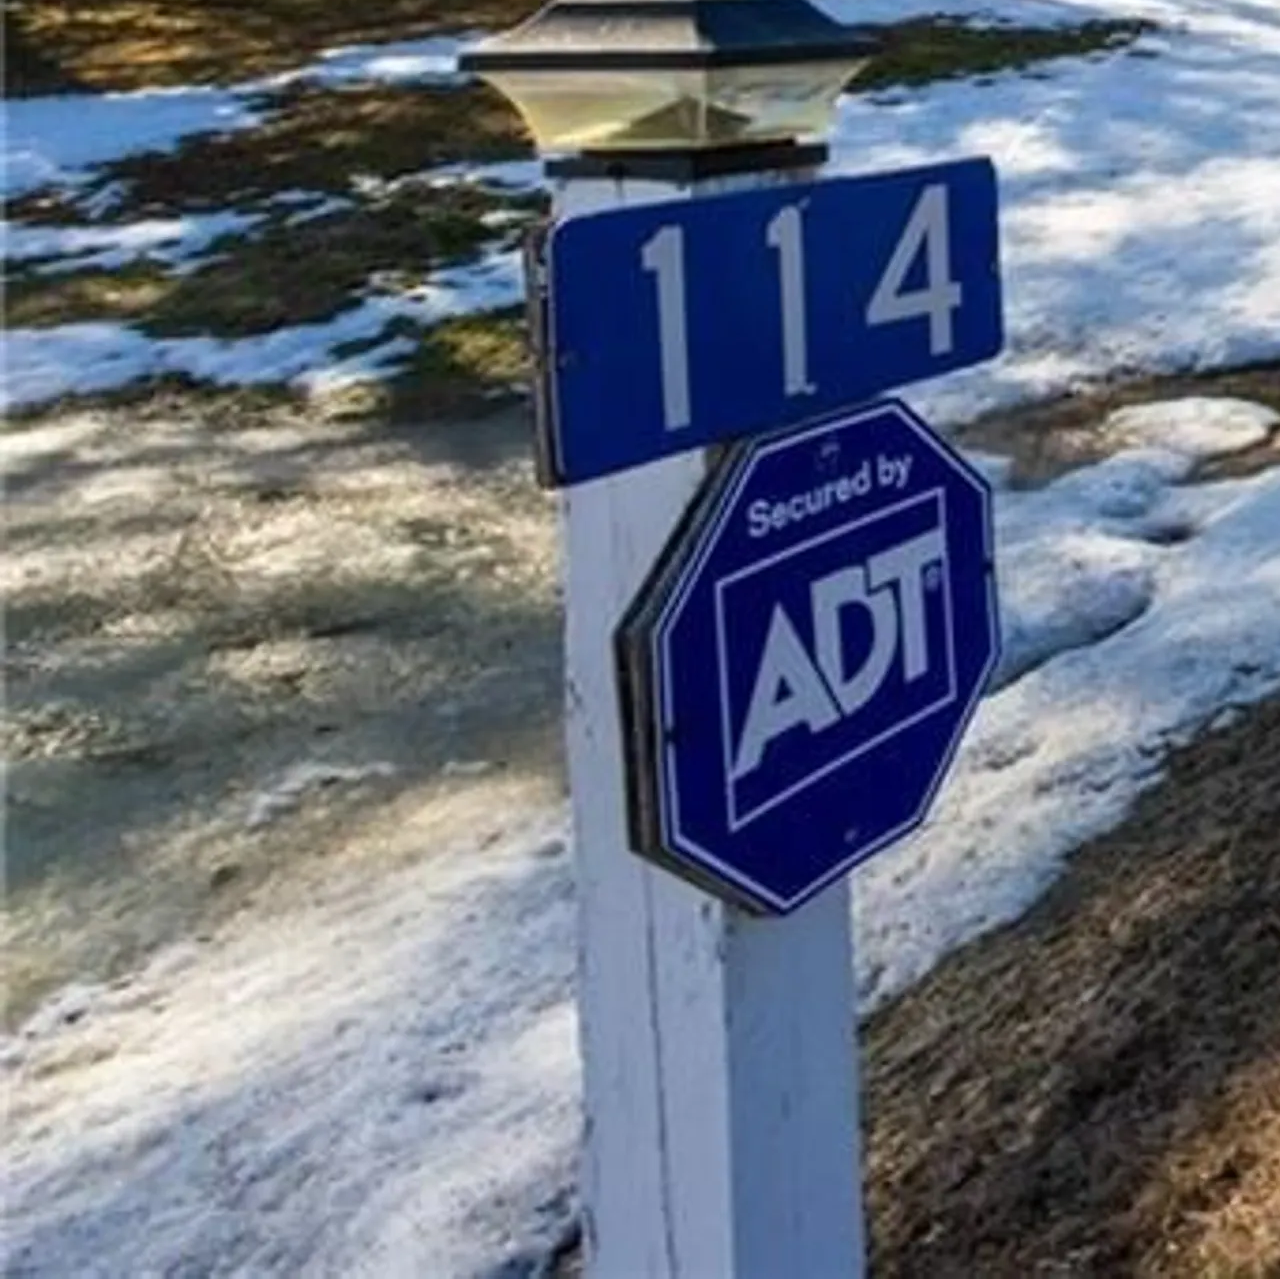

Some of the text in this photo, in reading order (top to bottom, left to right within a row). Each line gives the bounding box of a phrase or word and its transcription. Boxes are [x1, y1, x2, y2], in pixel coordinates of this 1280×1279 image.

[640, 184, 962, 432] 114
[746, 451, 914, 539] Secured by
[731, 527, 948, 783] ADT
